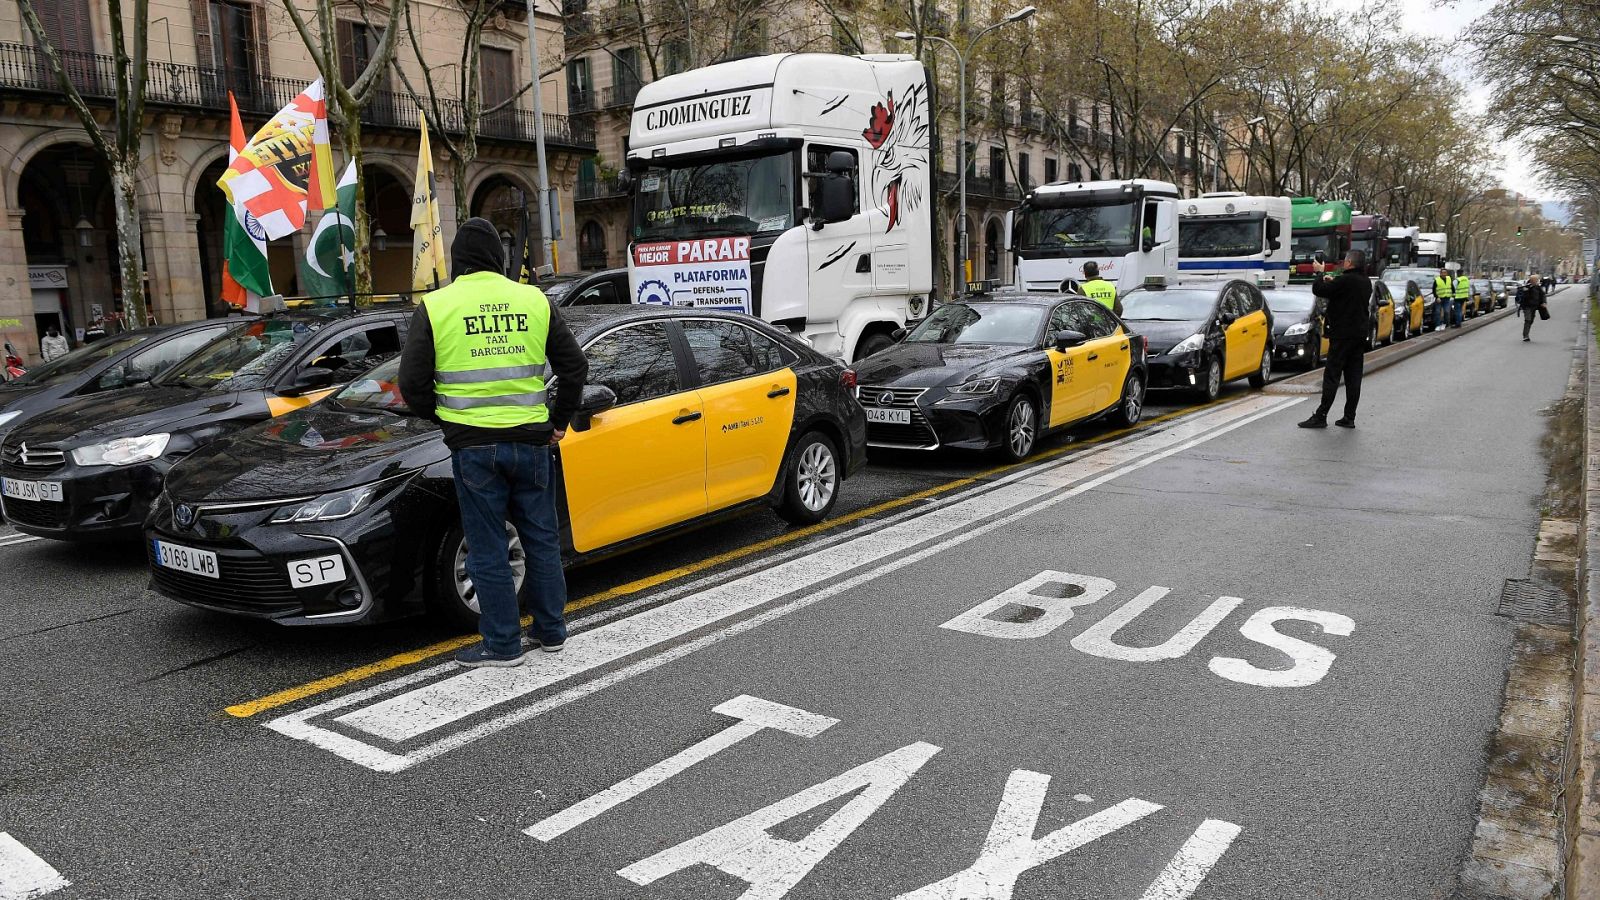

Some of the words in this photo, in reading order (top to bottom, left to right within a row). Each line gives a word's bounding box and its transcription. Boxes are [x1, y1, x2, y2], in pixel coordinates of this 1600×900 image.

[646, 95, 752, 131] C.DOMINGUEZ
[677, 238, 749, 262] PARAR
[639, 252, 669, 264] MEJOR
[674, 268, 748, 283] PLATAFORMA
[693, 286, 725, 294] DEFENSA
[968, 282, 983, 292] TAXI
[696, 297, 742, 306] TRANSPORTE
[1090, 291, 1112, 299] ELITE
[479, 303, 510, 312] STAFF
[463, 313, 528, 336] ELITE
[485, 335, 508, 344] TAXI
[470, 345, 526, 357] BARCELONA
[866, 409, 886, 421] 048
[888, 411, 908, 422] KYL
[22, 483, 37, 498] JSK
[161, 545, 189, 569] 3169
[191, 553, 215, 575] LWB
[939, 569, 1357, 689] BUS
[522, 693, 1243, 900] TAXI
